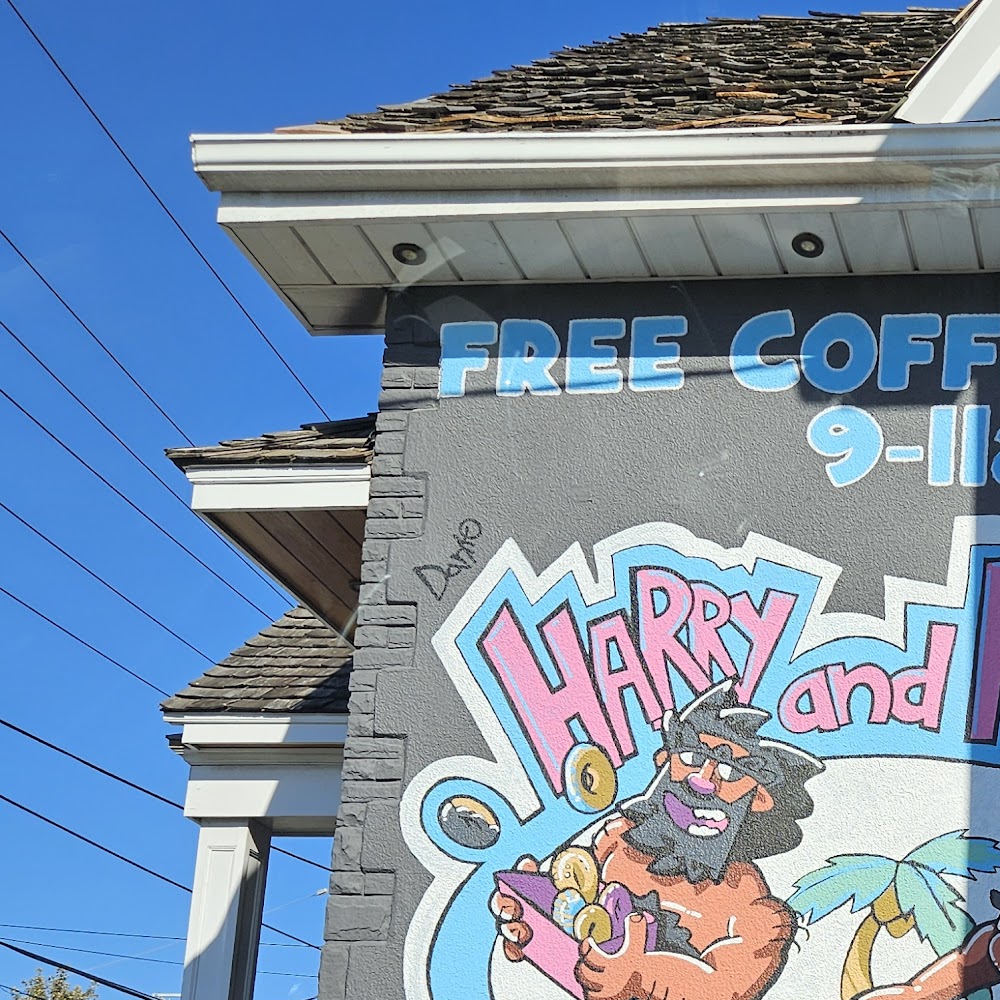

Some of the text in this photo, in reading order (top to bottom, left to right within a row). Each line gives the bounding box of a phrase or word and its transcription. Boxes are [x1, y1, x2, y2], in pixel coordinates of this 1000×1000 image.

[439, 315, 687, 398] FREE
[476, 565, 800, 796] HARRY
[777, 620, 958, 734] and
